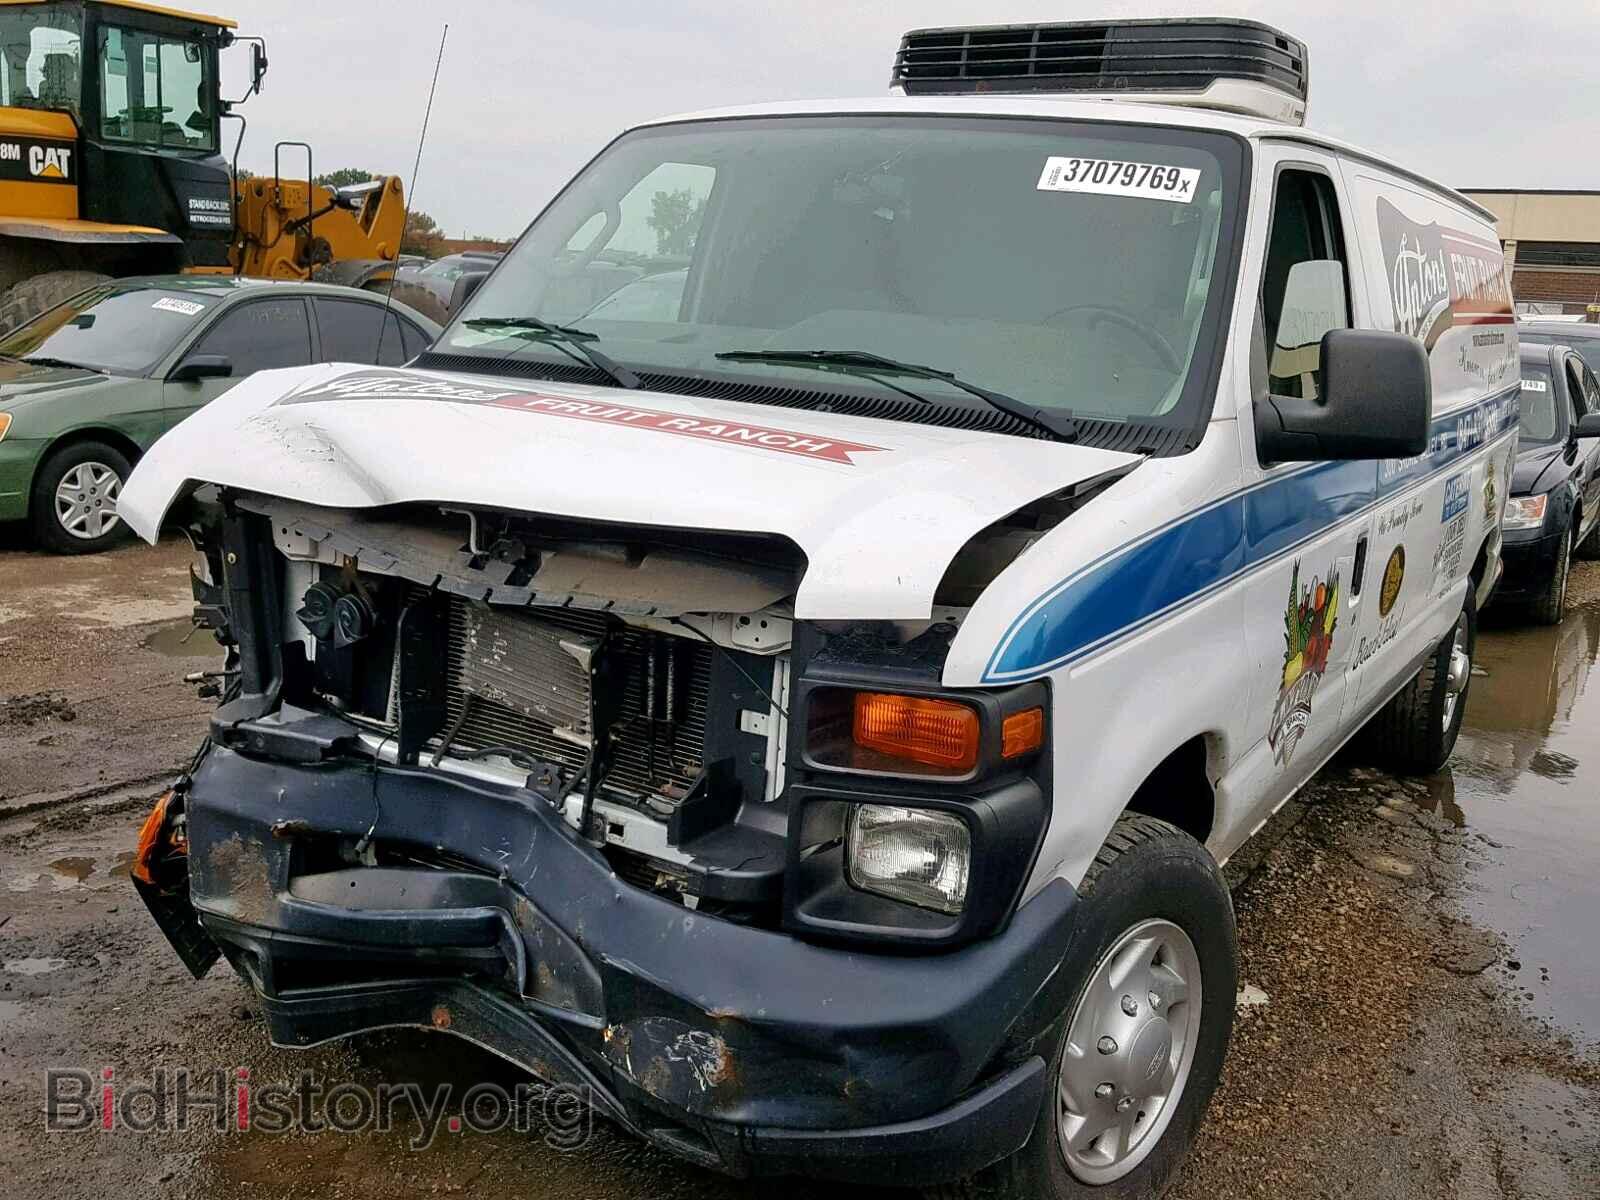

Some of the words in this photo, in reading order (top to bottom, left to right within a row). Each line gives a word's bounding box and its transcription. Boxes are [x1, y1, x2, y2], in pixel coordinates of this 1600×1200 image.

[29, 146, 71, 178] CAT
[1063, 159, 1181, 191] 37079769
[1451, 252, 1482, 300] FRUIT
[526, 398, 655, 421] FRUIT
[653, 418, 832, 452] RANCH
